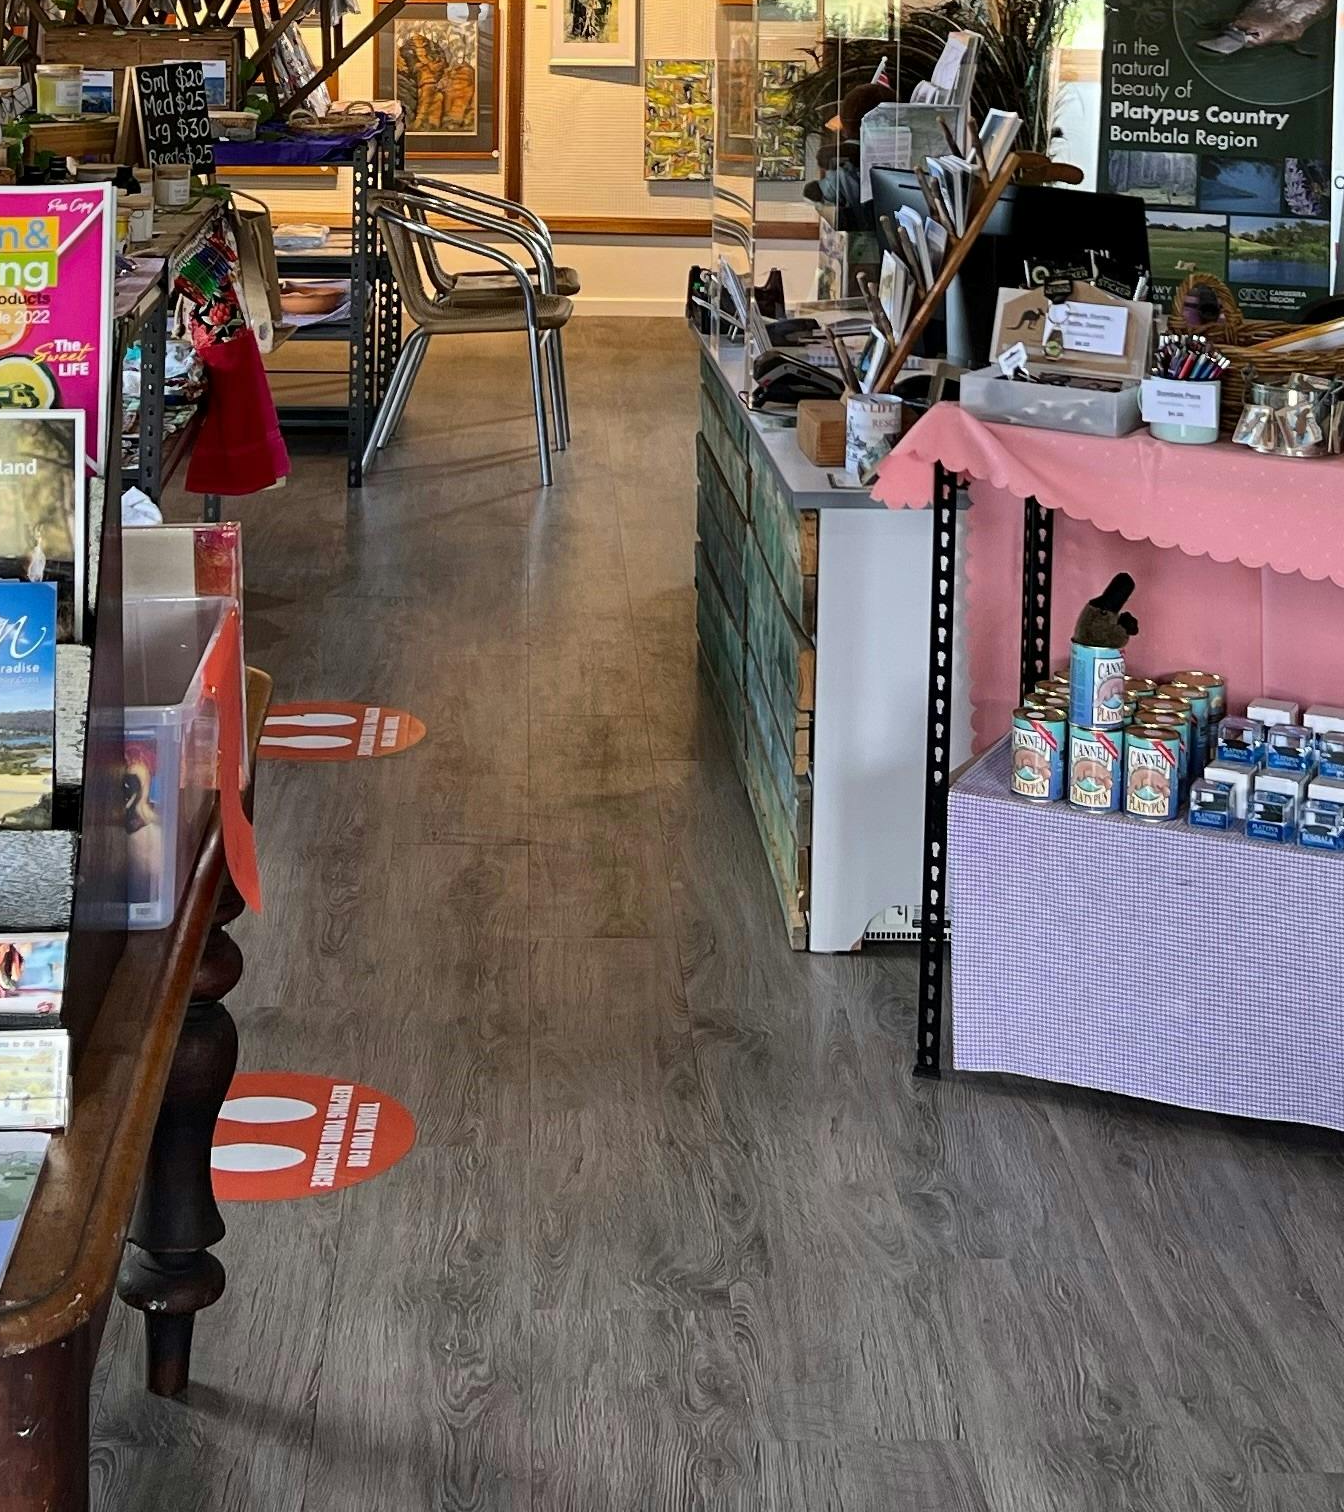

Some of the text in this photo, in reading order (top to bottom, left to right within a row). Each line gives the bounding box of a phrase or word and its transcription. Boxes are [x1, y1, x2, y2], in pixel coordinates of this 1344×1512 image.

[1112, 37, 1160, 57] in the
[1112, 59, 1169, 77] natural
[140, 66, 204, 93] Sml $20
[1111, 77, 1192, 102] beauty of
[144, 90, 205, 117] Med $25
[1110, 101, 1290, 130] Platypus Country
[147, 117, 210, 144] Lrg $30
[1110, 126, 1258, 150] Bombala Region
[185, 144, 213, 168] $25
[25, 219, 49, 250] &
[1269, 296, 1295, 304] REGION
[15, 310, 50, 324] 2022
[32, 342, 96, 364] Sweet
[55, 339, 81, 351] The
[58, 362, 89, 376] LIFE
[1014, 729, 1047, 752] CANNED
[1073, 741, 1110, 762] CANNED
[1130, 749, 1168, 770] CANNED
[1072, 789, 1109, 806] PLATYPUS
[1128, 797, 1167, 815] PLATYPUS
[350, 1131, 375, 1149] YOU
[309, 1144, 342, 1188] DISTANCE
[346, 1150, 372, 1168] FOR
